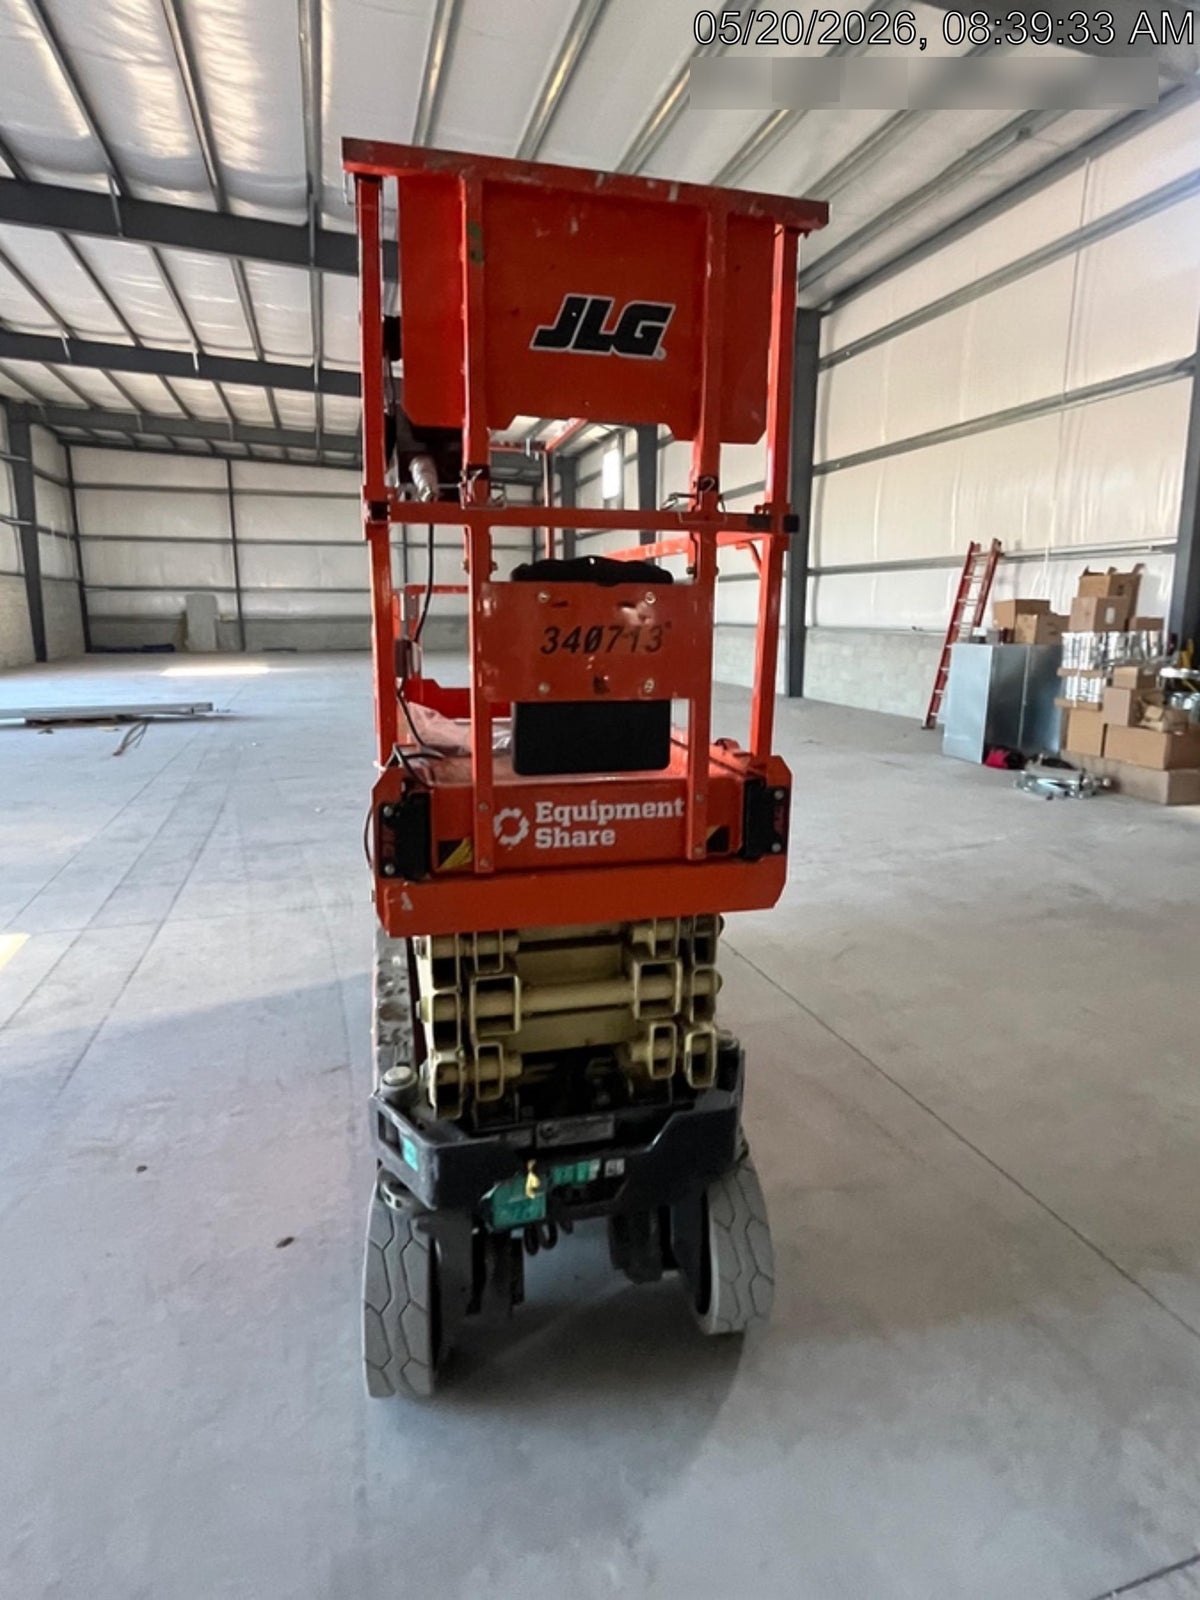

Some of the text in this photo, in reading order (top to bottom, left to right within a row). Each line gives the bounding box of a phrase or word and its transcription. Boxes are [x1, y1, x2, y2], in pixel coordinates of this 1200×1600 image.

[529, 293, 676, 360] JLG
[540, 625, 665, 655] 340713
[534, 798, 685, 827] Equipment
[534, 825, 616, 849] Share
